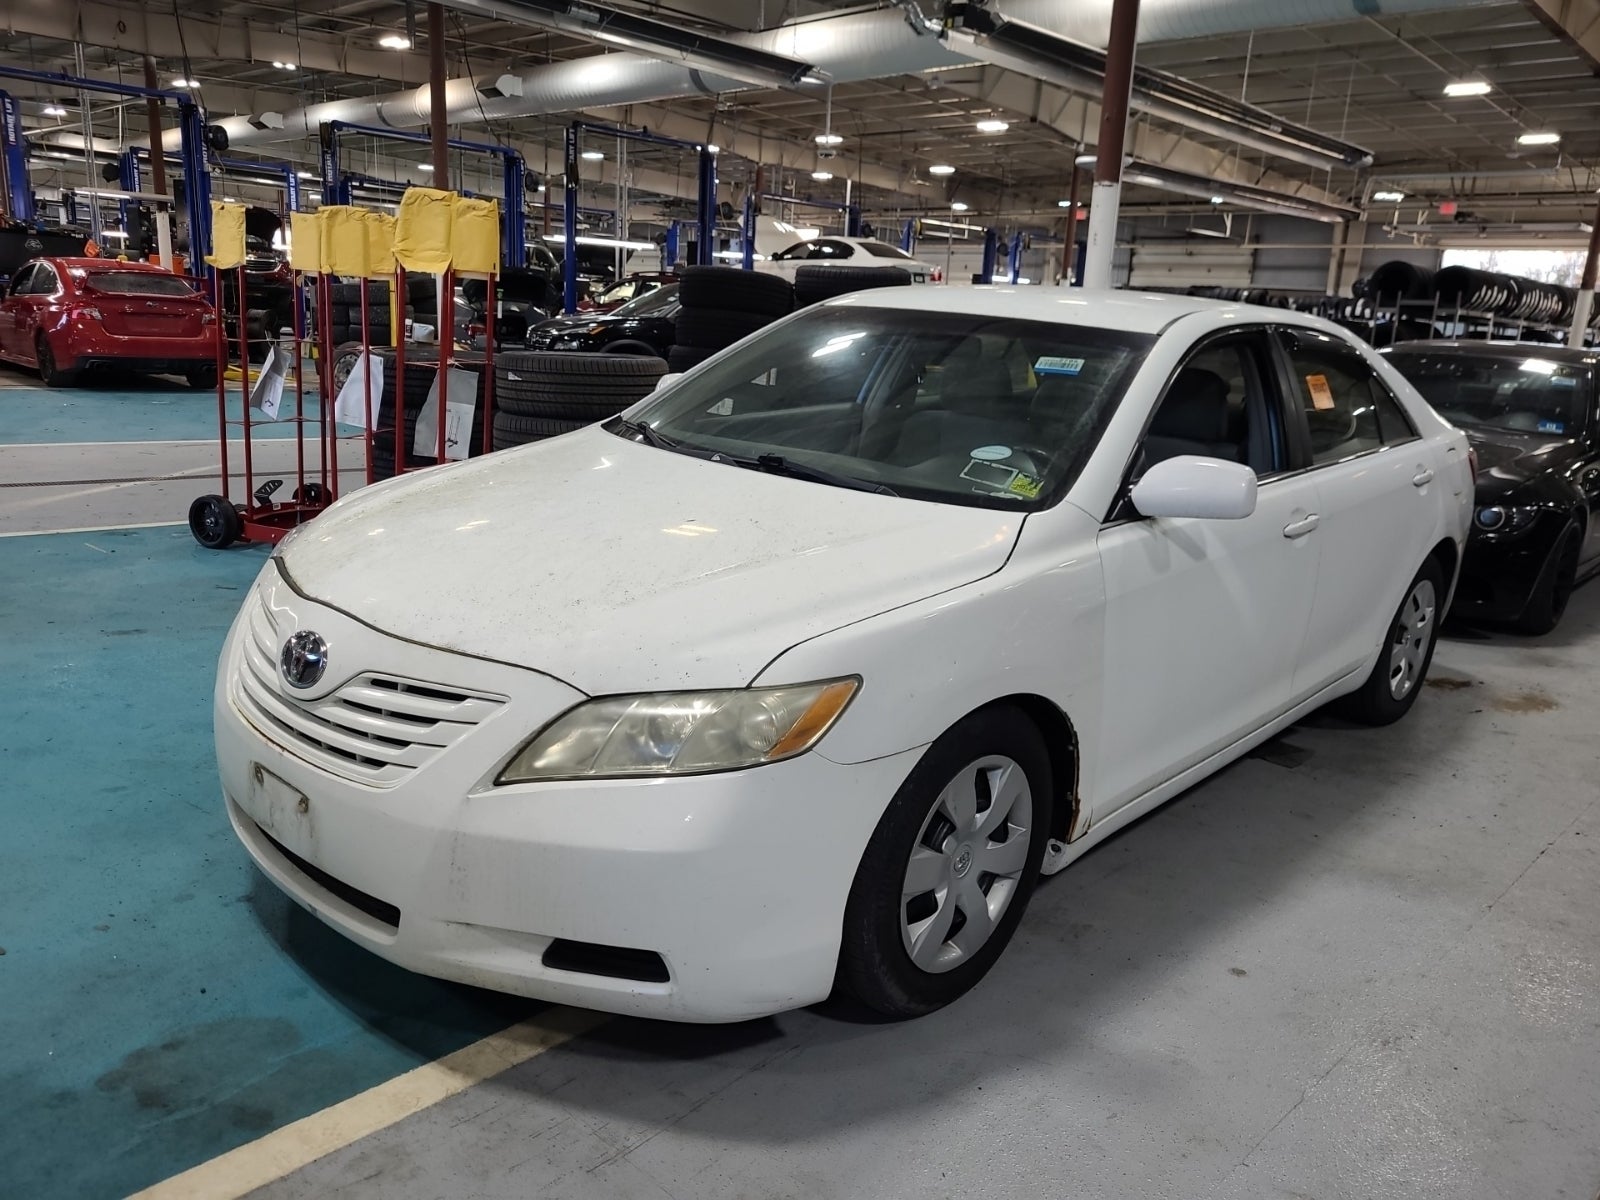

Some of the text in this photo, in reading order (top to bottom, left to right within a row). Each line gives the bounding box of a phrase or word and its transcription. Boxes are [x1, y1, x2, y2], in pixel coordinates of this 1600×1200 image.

[5, 98, 16, 142] ROTARY LIFT
[325, 154, 333, 182] ROTAR
[289, 186, 297, 211] ROTARY
